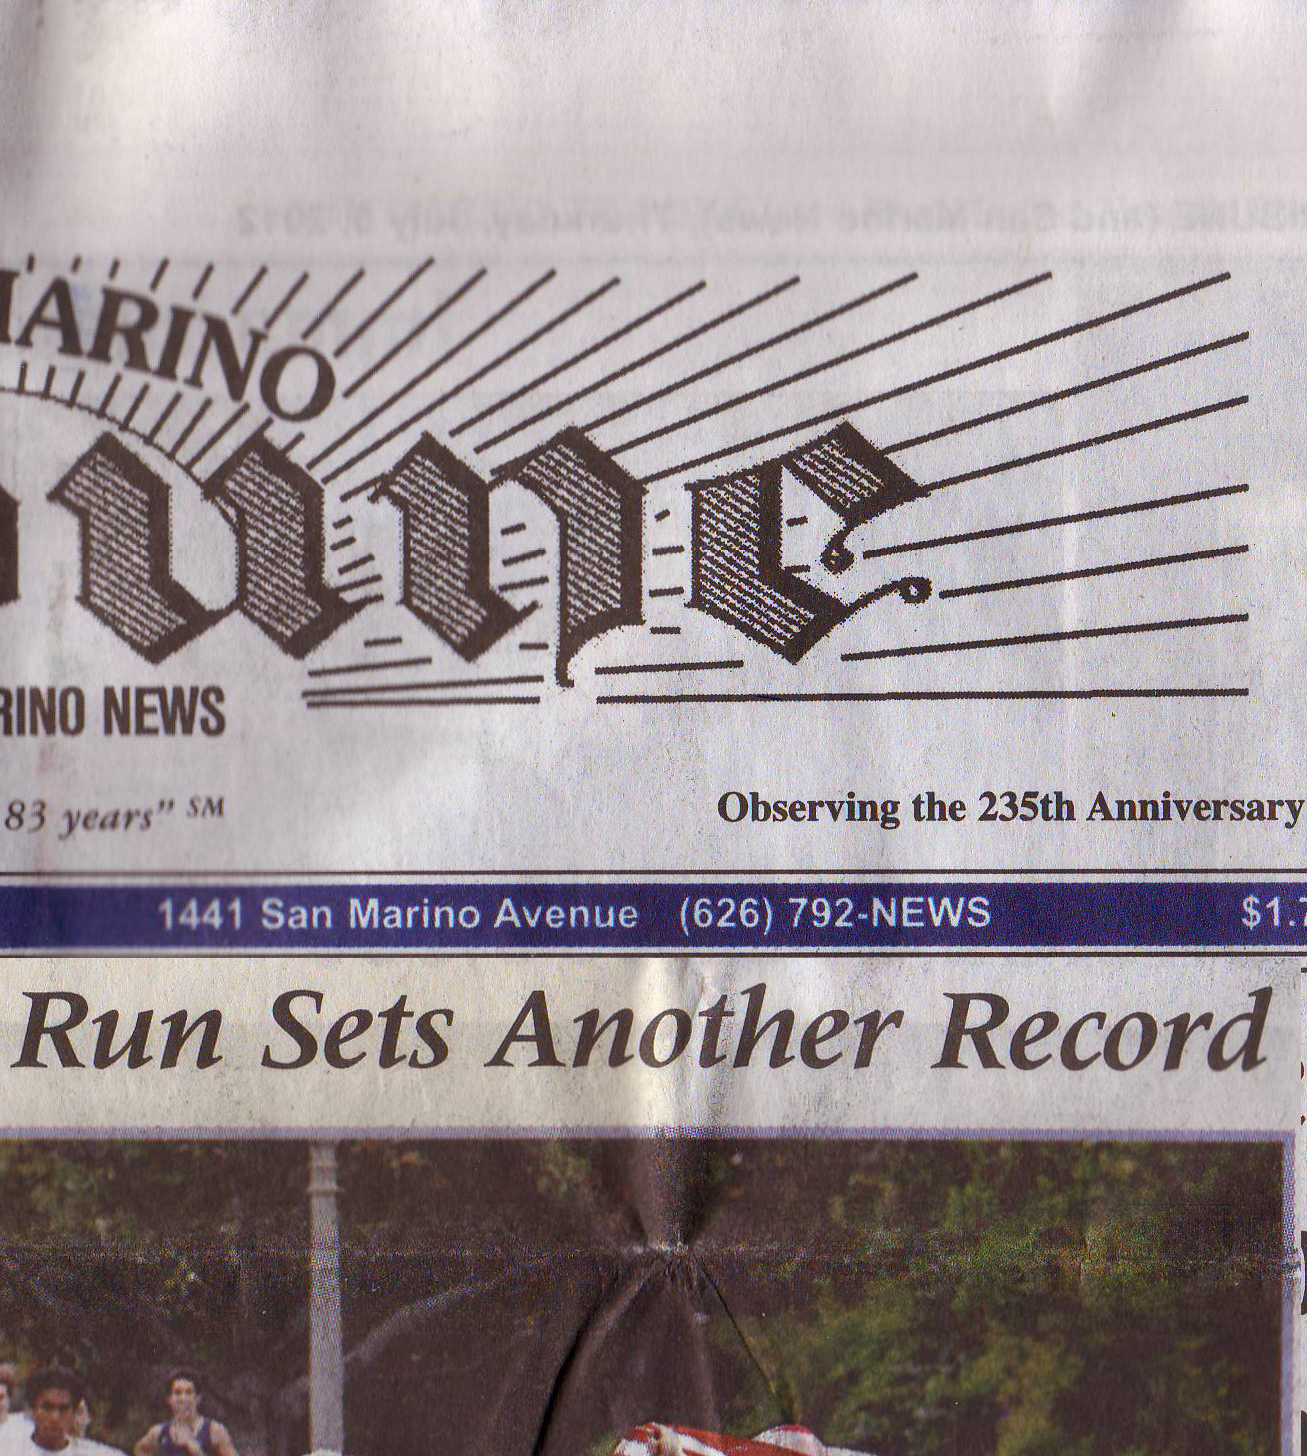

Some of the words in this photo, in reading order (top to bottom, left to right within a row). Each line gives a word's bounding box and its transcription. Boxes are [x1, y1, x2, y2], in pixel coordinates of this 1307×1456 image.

[103, 685, 226, 738] NEWS
[4, 801, 47, 833] 83
[717, 790, 901, 831] Observing
[911, 790, 967, 823] the
[977, 790, 1077, 823] 235th
[1085, 790, 1307, 830] Anniversary
[160, 898, 241, 930] 1441
[261, 897, 332, 930] San
[349, 897, 481, 929] Marino
[493, 897, 639, 929] Avenue
[679, 896, 773, 936] (626)
[788, 895, 991, 928] 792-NEWS
[9, 990, 223, 1070] Run
[260, 988, 455, 1071] Sets
[483, 982, 905, 1070] Another
[930, 985, 1274, 1071] Record
